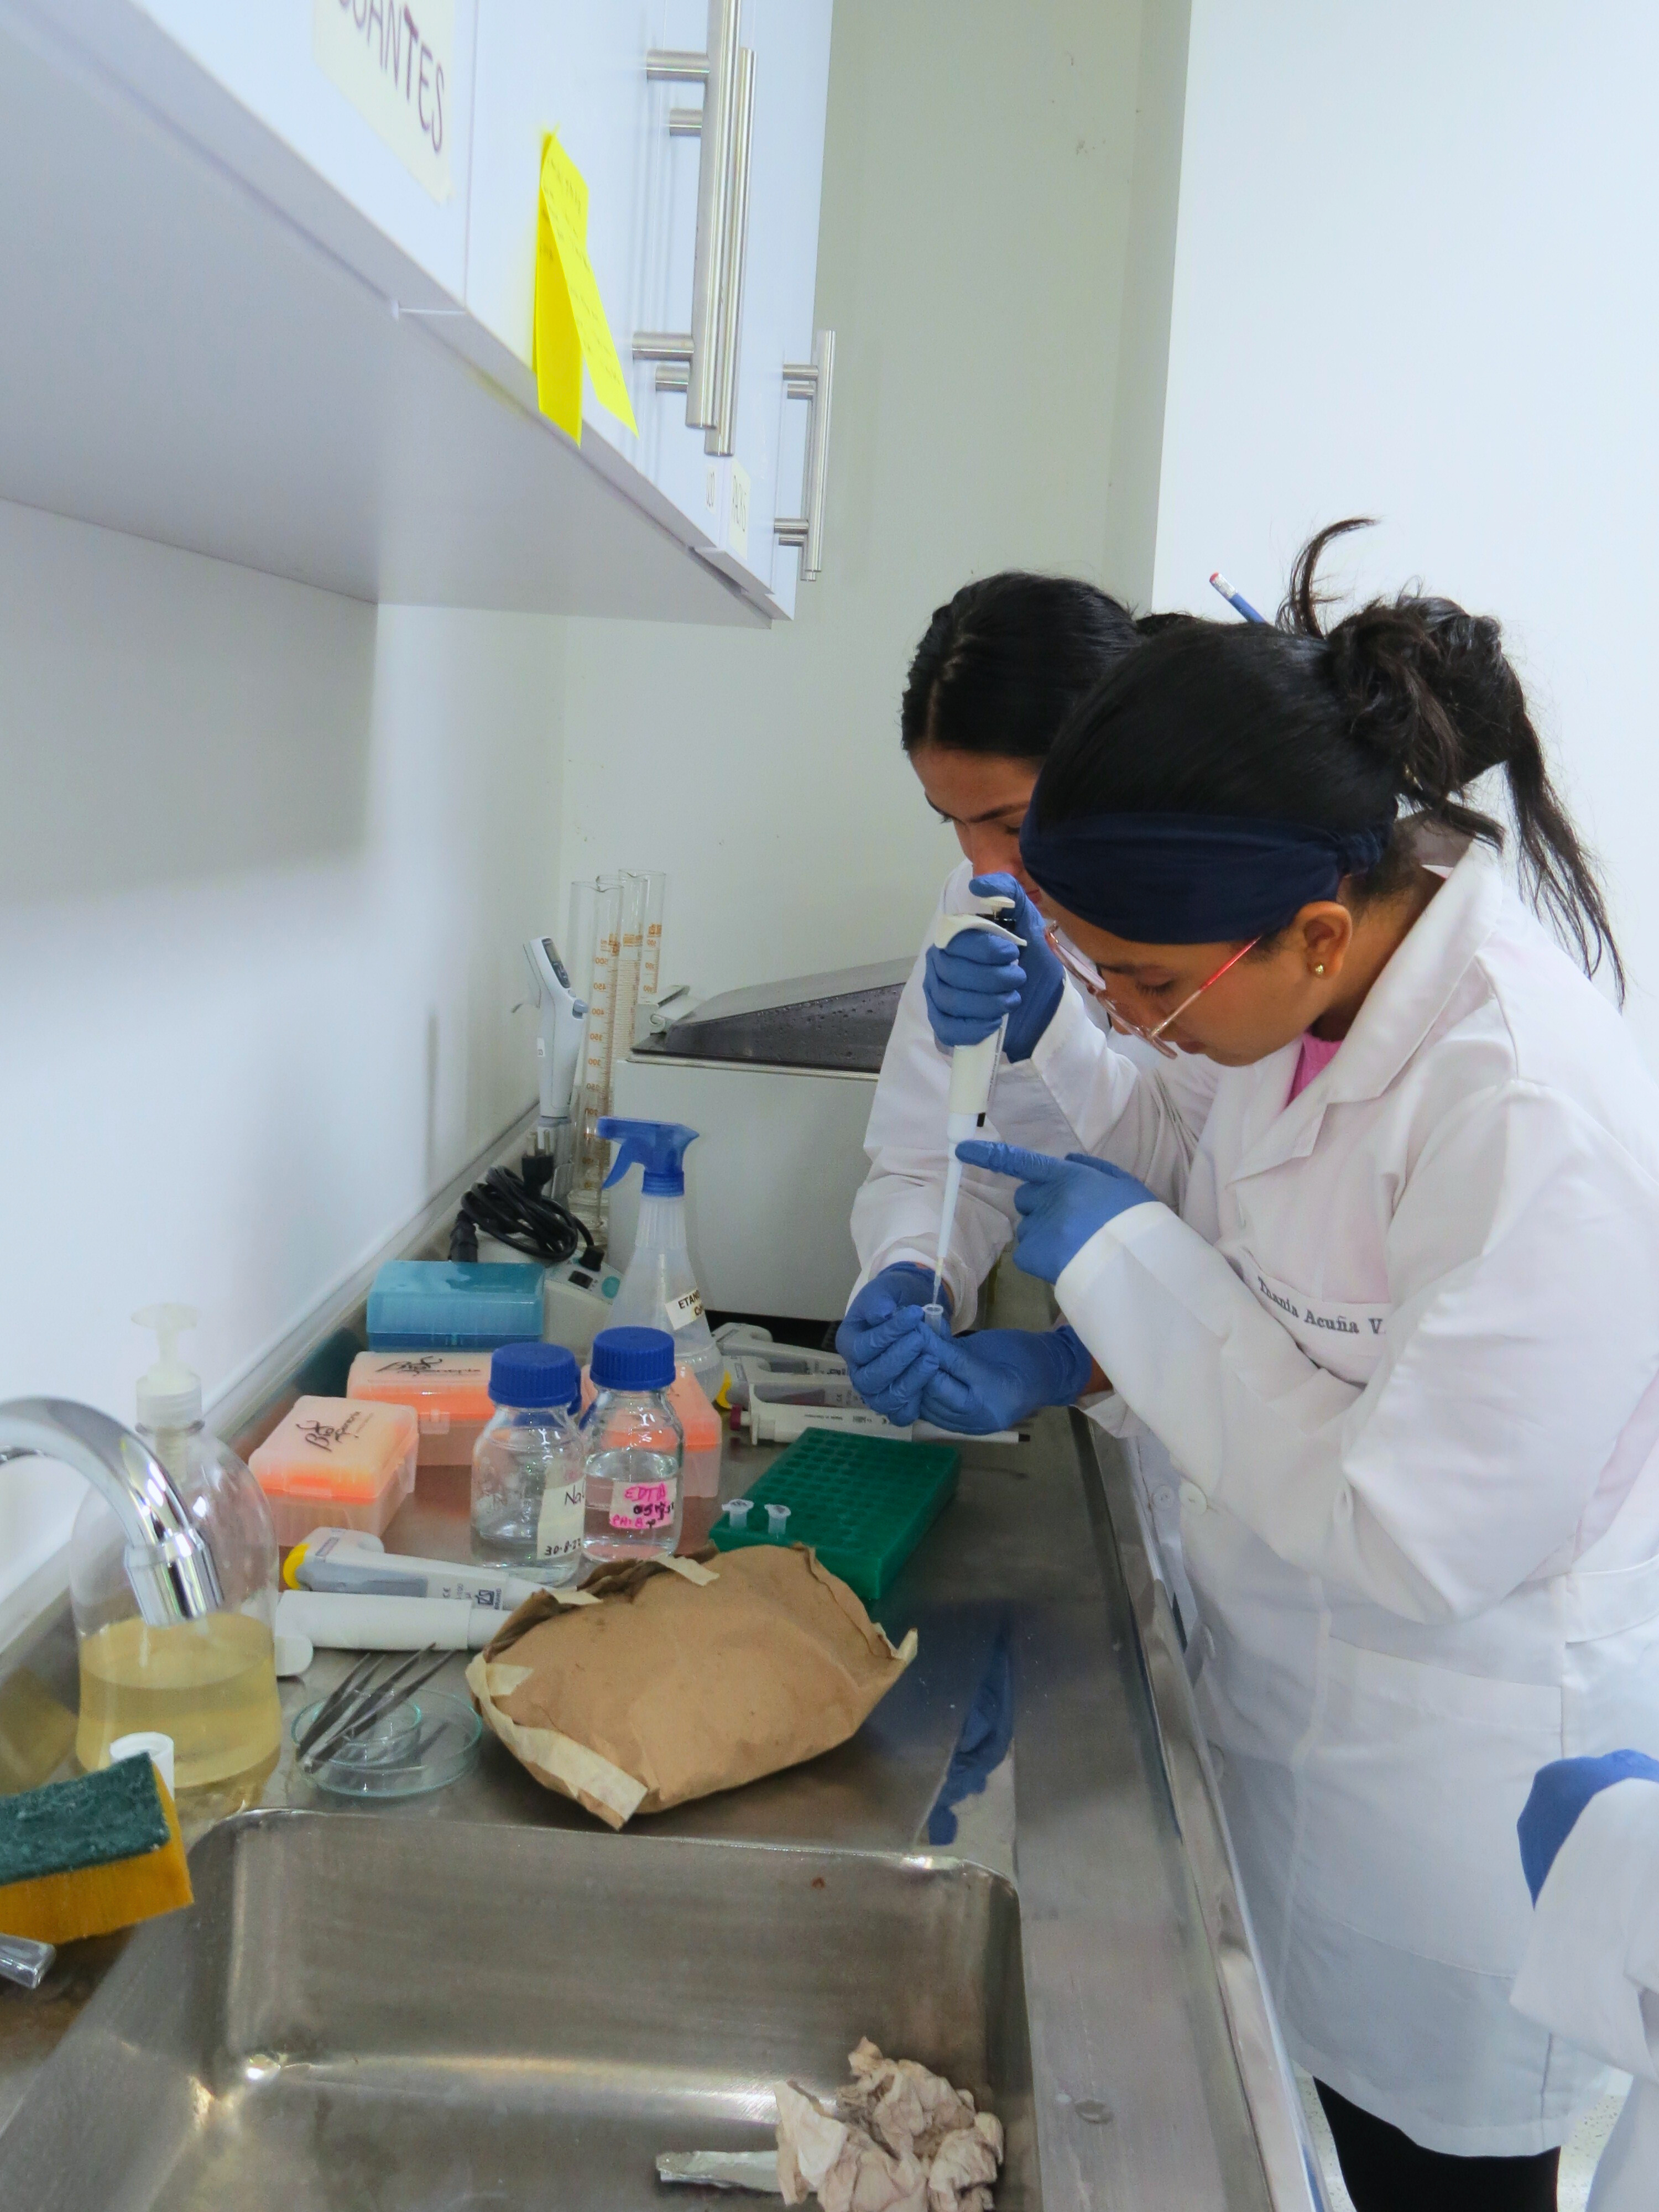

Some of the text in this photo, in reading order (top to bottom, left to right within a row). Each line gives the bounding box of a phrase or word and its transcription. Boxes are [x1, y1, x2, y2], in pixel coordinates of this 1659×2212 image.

[1258, 1276, 1300, 1318] Thania
[1303, 1309, 1360, 1334] Acuña
[624, 1483, 666, 1501] EDTA
